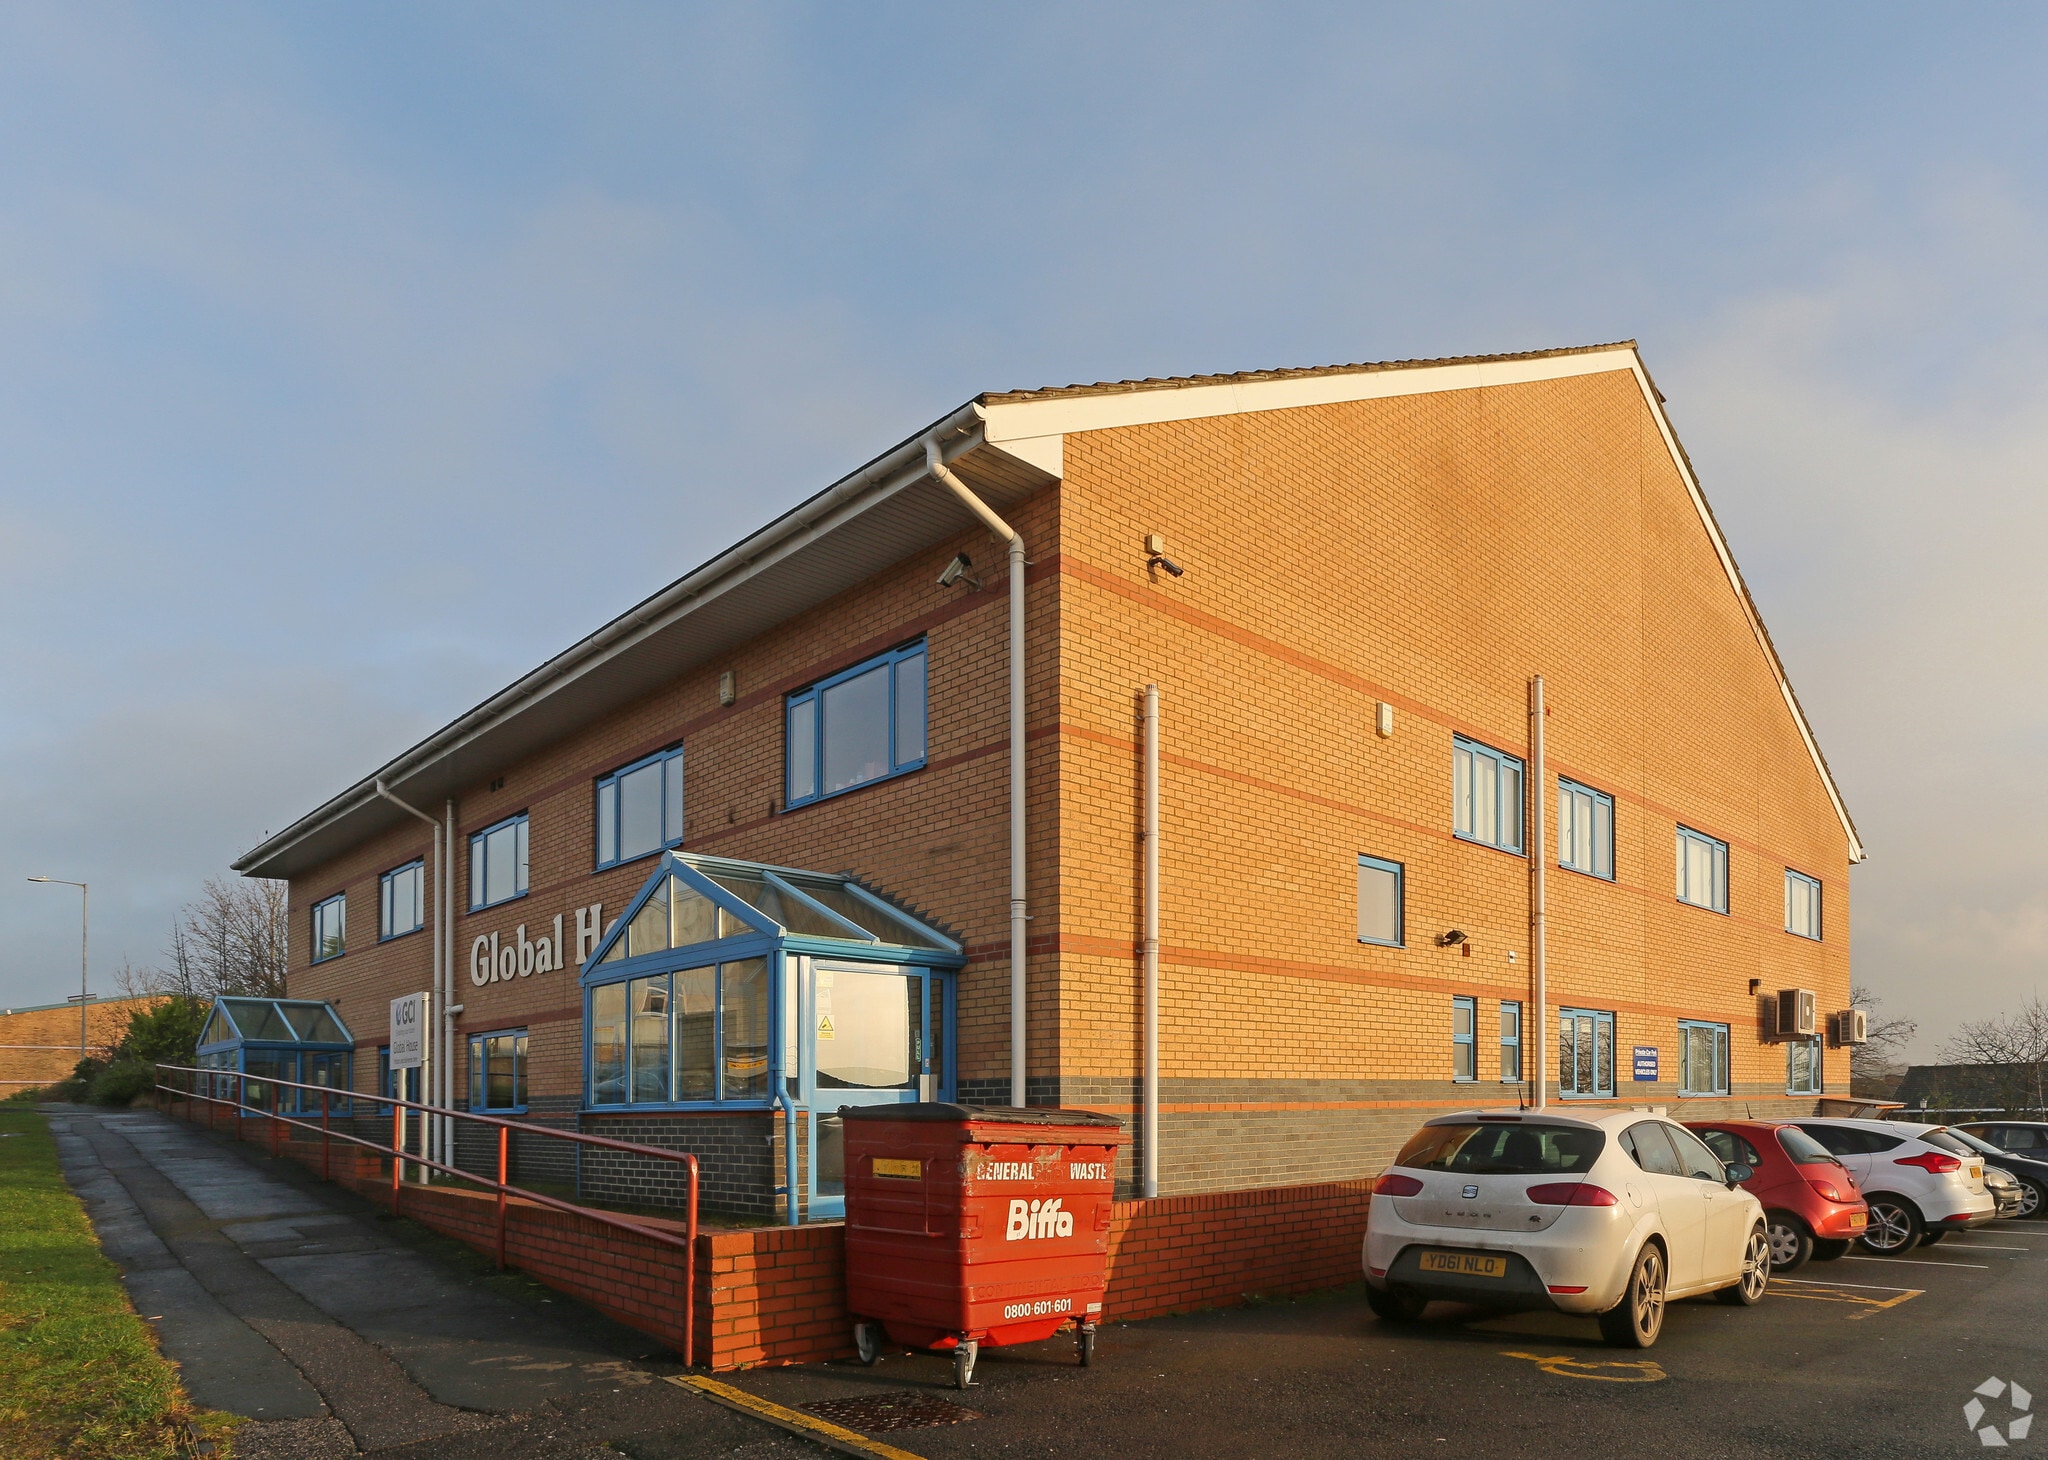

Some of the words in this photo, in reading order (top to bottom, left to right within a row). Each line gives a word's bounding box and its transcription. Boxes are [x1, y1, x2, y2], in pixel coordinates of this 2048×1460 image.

[471, 913, 564, 987] Global
[976, 1162, 1035, 1181] GENERAL
[1070, 1162, 1107, 1181] WASTE
[1005, 1198, 1074, 1241] Biffa
[1429, 1254, 1462, 1271] YD61
